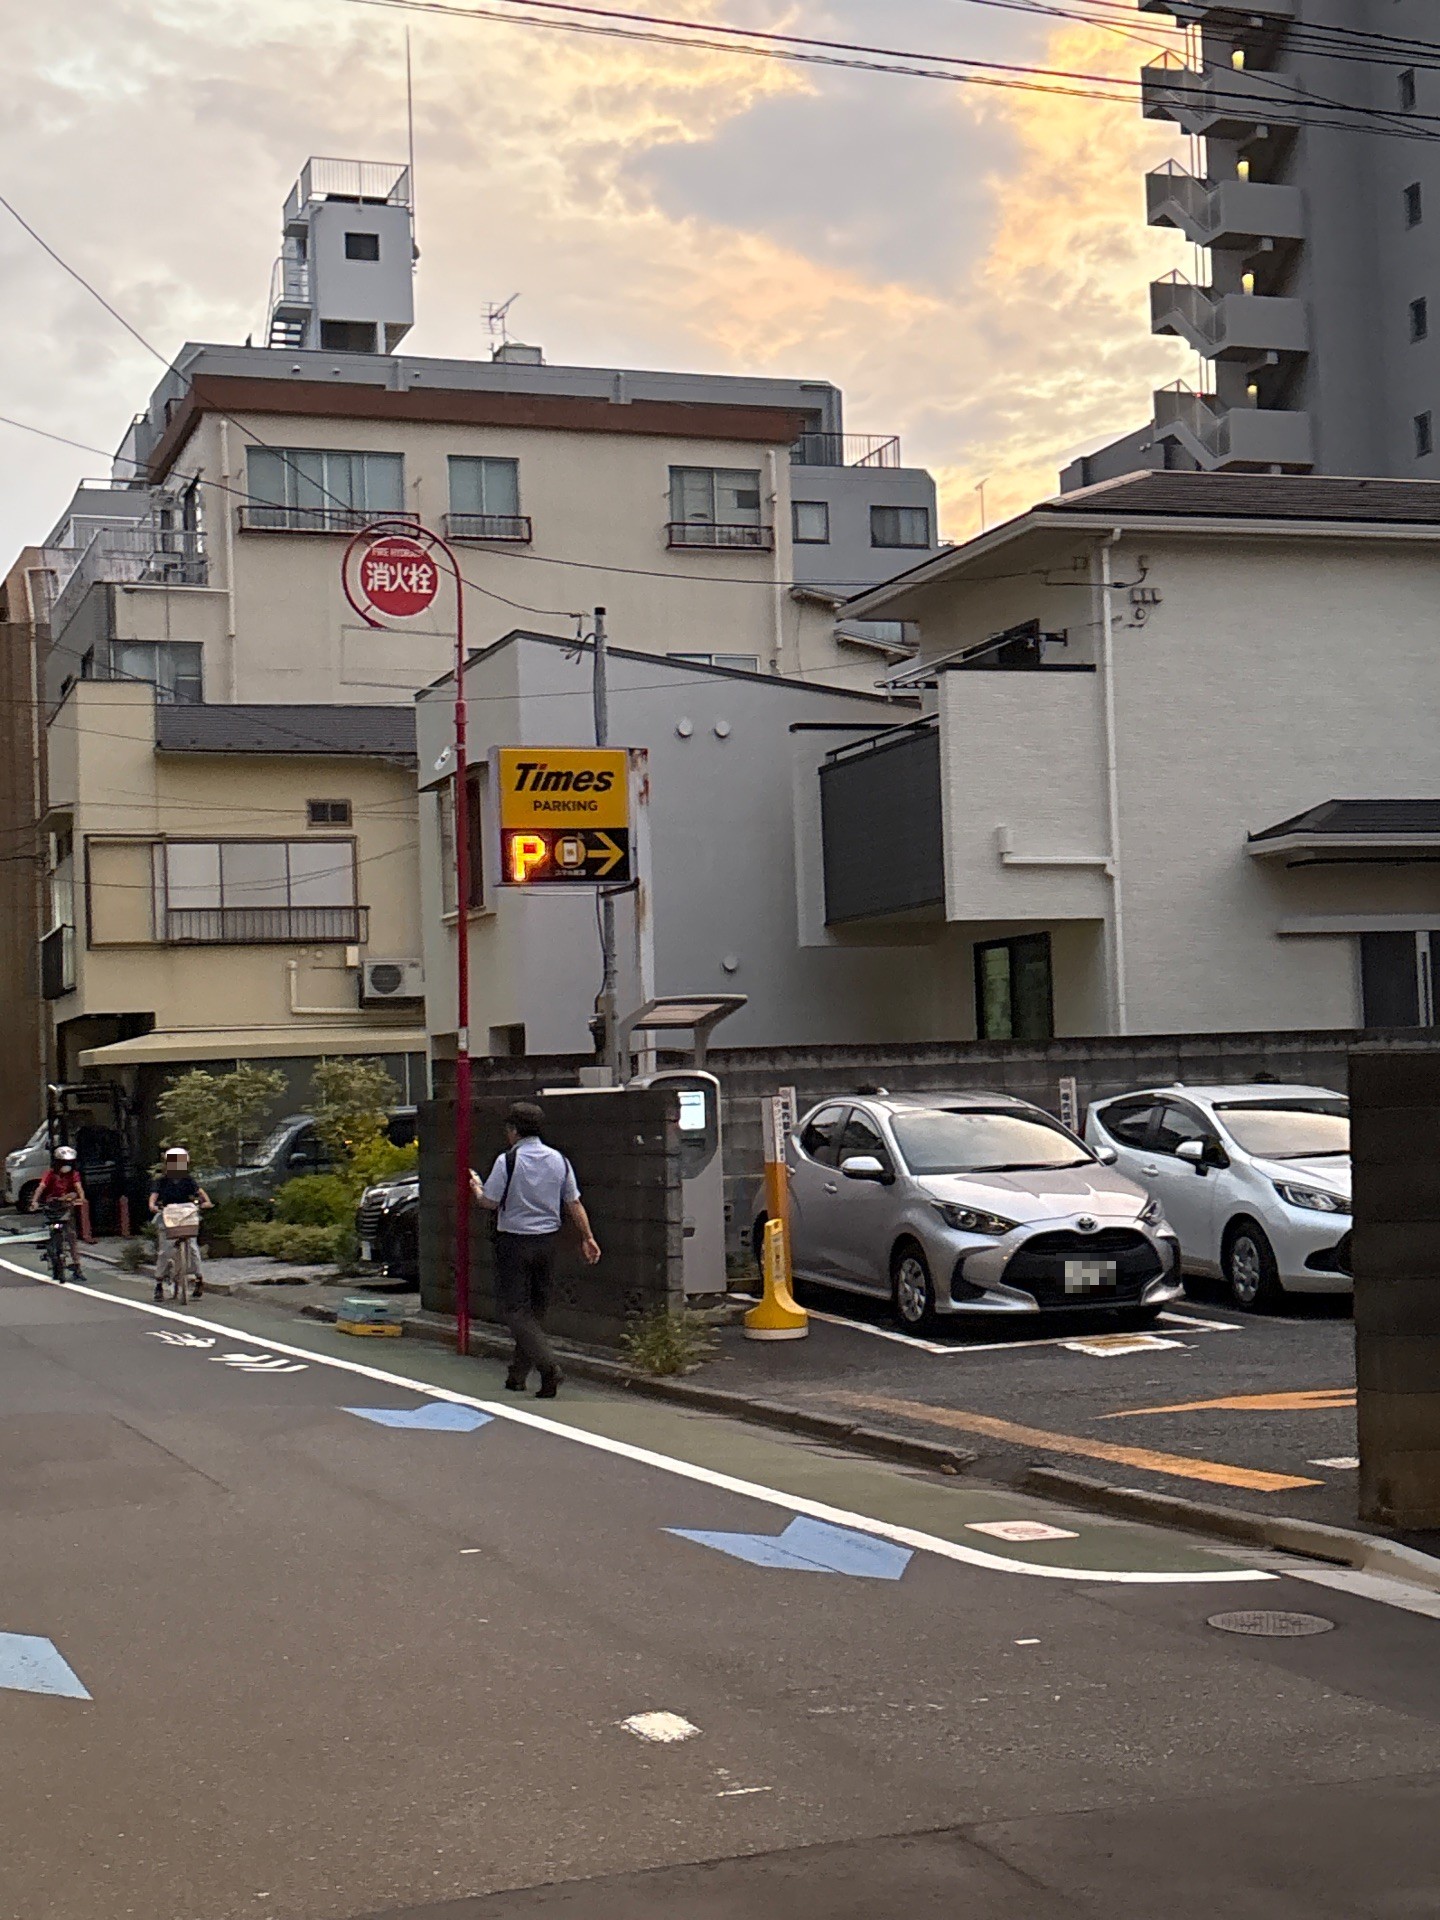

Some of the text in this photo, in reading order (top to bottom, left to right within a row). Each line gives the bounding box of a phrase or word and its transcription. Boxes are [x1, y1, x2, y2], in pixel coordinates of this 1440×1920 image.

[366, 561, 434, 595] 消火栓
[514, 763, 615, 792] Times
[533, 800, 598, 812] PARKING
[511, 835, 546, 881] P
